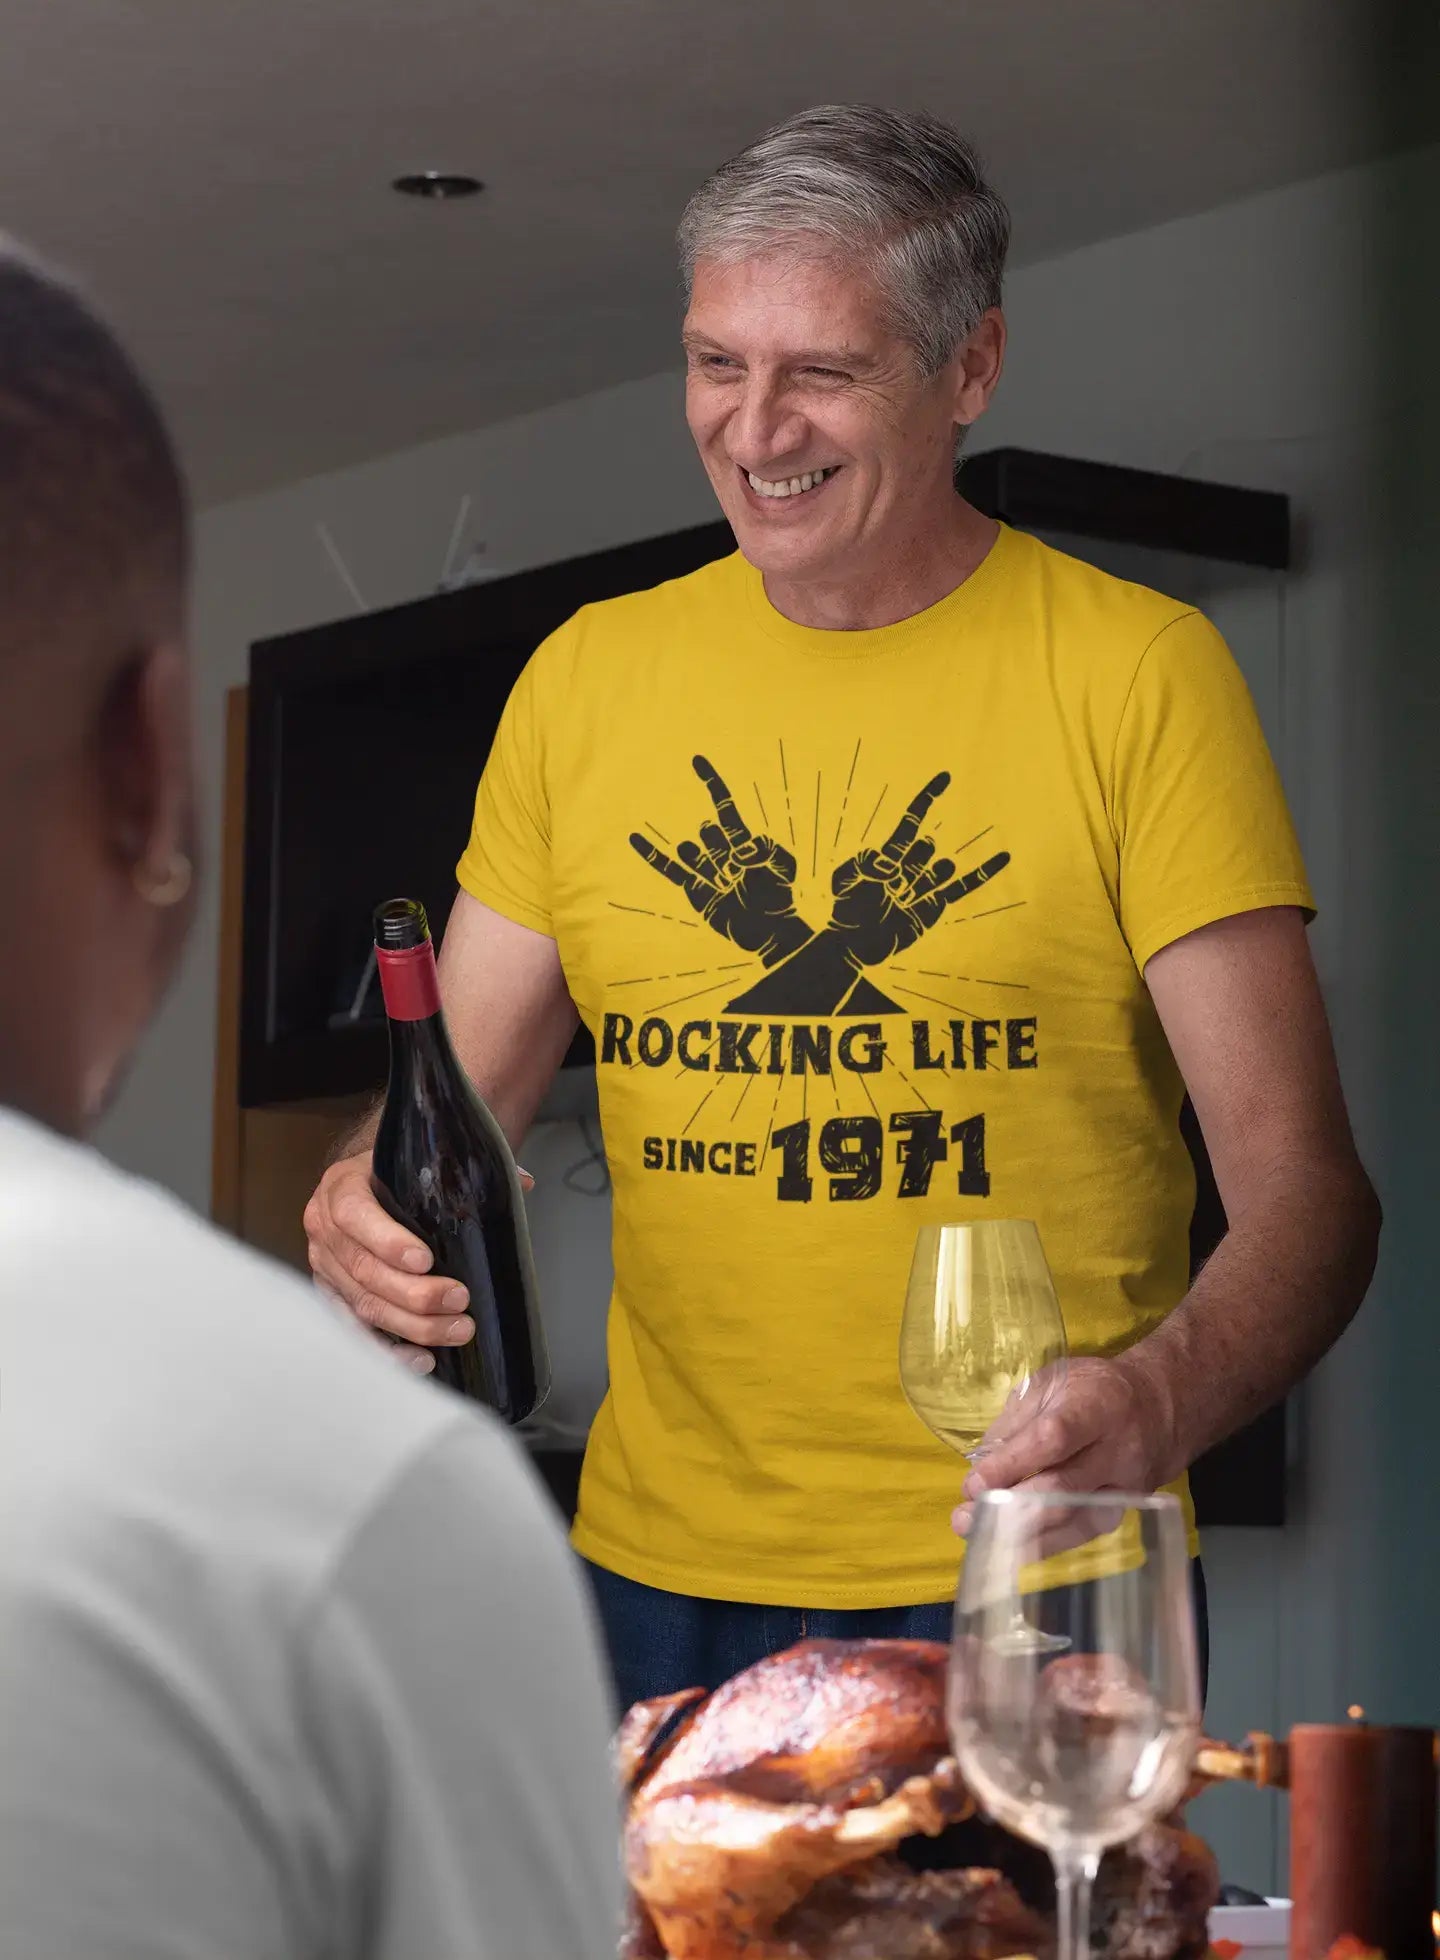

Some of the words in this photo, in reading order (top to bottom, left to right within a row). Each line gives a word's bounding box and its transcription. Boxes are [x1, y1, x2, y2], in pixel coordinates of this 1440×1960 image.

[601, 1012, 888, 1075] ROCKING
[911, 1016, 1039, 1071] LIFE
[643, 1136, 757, 1176] SINCE
[771, 1108, 991, 1204] 1971
